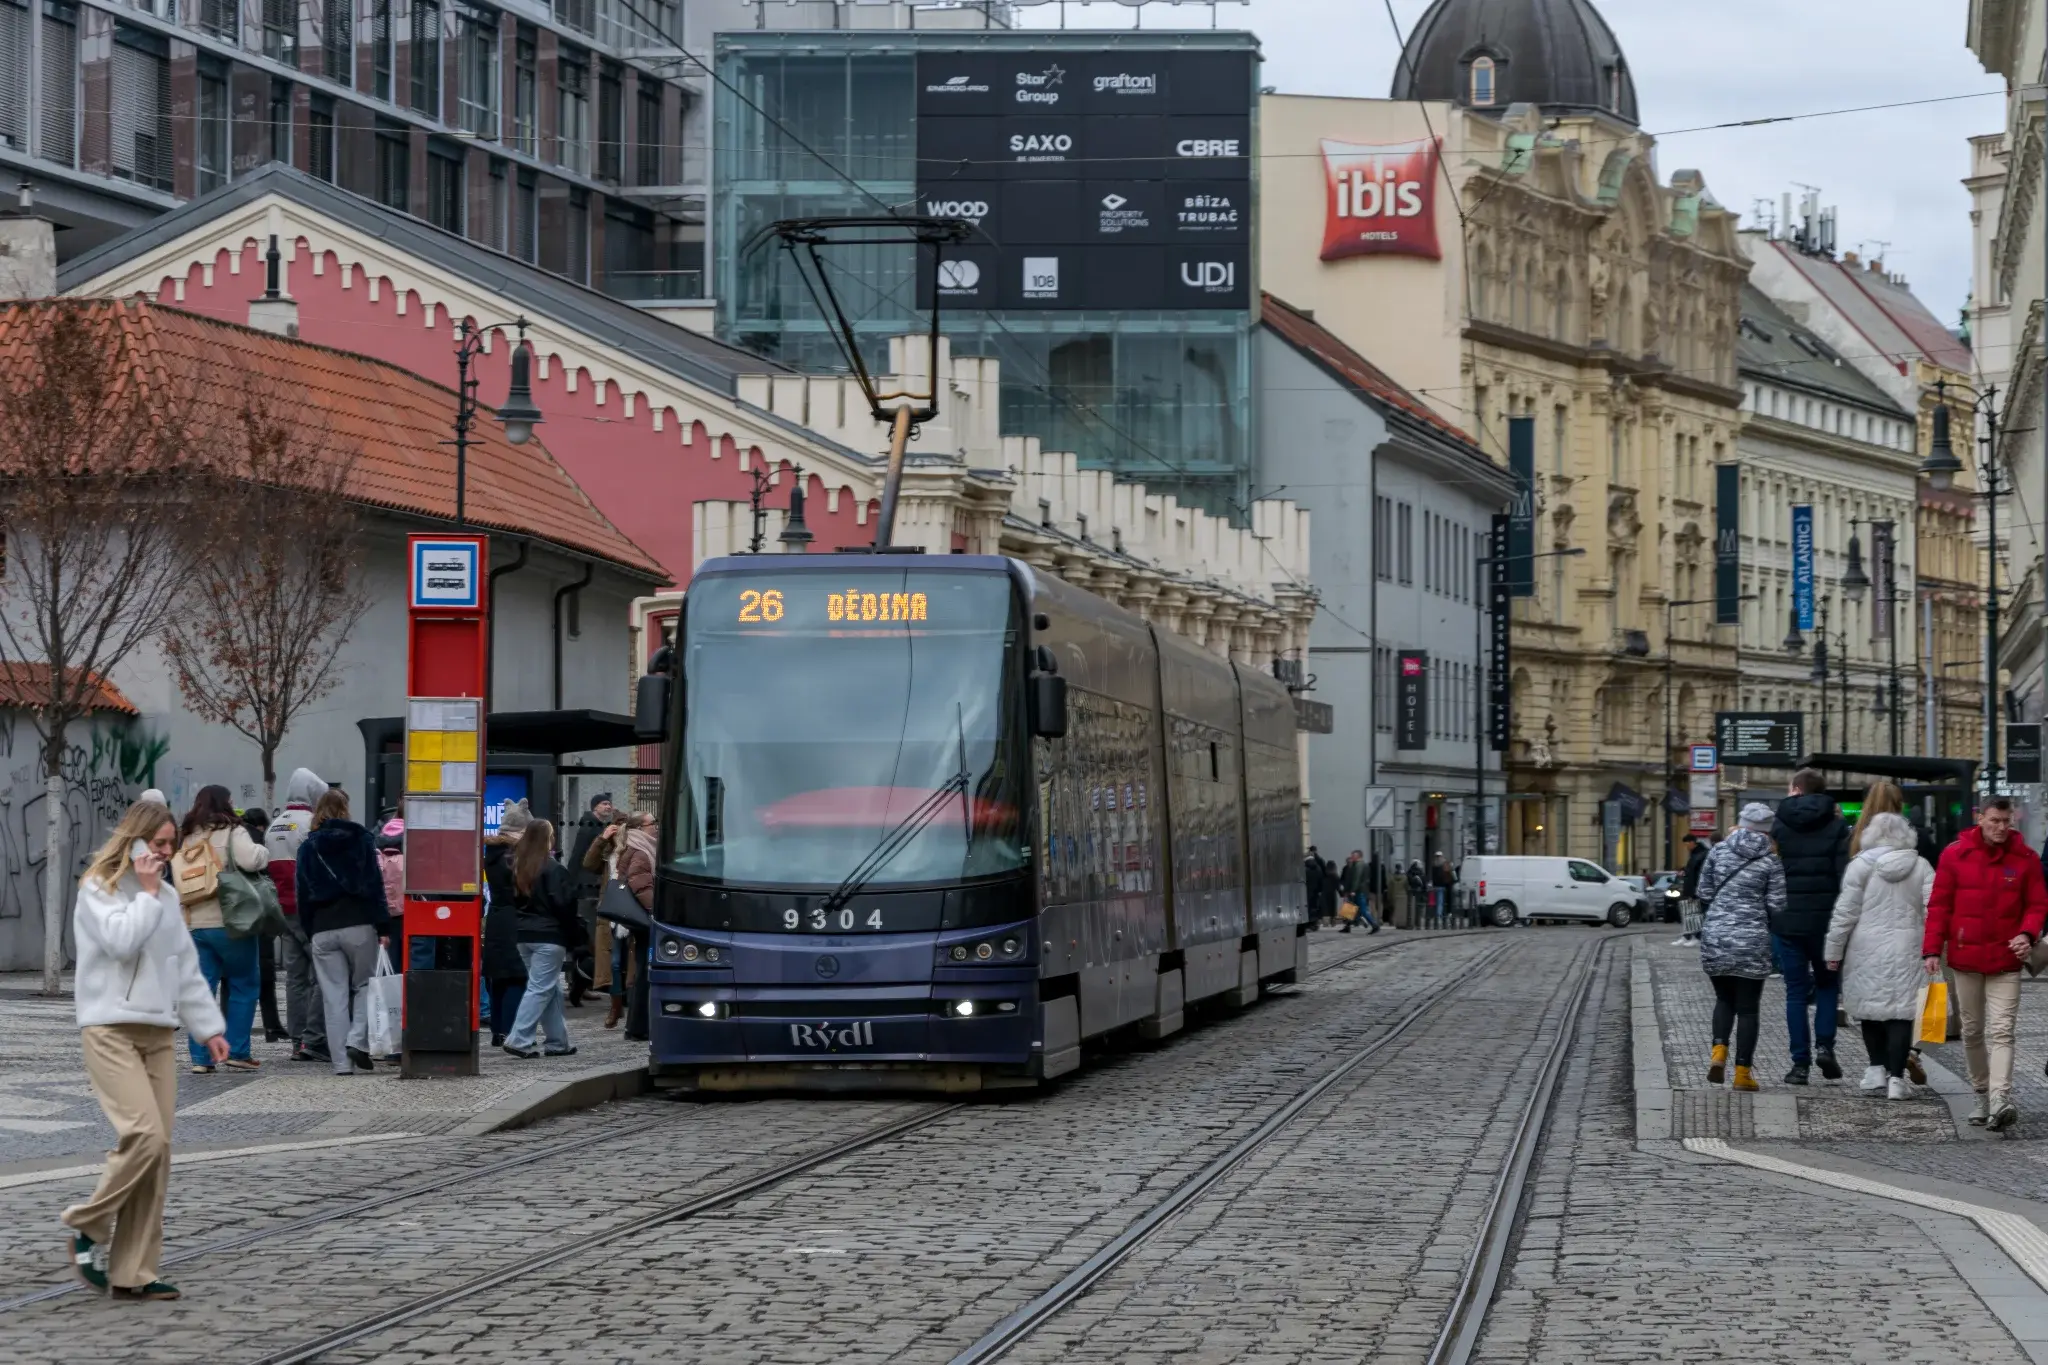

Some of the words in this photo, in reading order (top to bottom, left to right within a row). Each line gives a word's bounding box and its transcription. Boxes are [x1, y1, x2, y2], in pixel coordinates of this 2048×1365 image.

[1015, 72, 1047, 85] Star
[1093, 73, 1153, 91] grafton
[1015, 89, 1059, 104] Group
[1010, 134, 1073, 151] SAXO
[1176, 139, 1240, 157] CBRE
[1337, 170, 1422, 218] ibis
[926, 201, 989, 217] WOOD
[1177, 209, 1238, 222] TRUBAČ
[1360, 231, 1398, 240] HOTELS
[1032, 275, 1056, 288] 108
[1181, 262, 1235, 286] UDI
[1797, 523, 1811, 585] ATLANTIC
[739, 590, 784, 622] 26
[828, 589, 927, 621] DĚDINA
[1406, 683, 1417, 743] HOTEL
[784, 908, 883, 930] 9304
[790, 1021, 874, 1050] Rýdl
